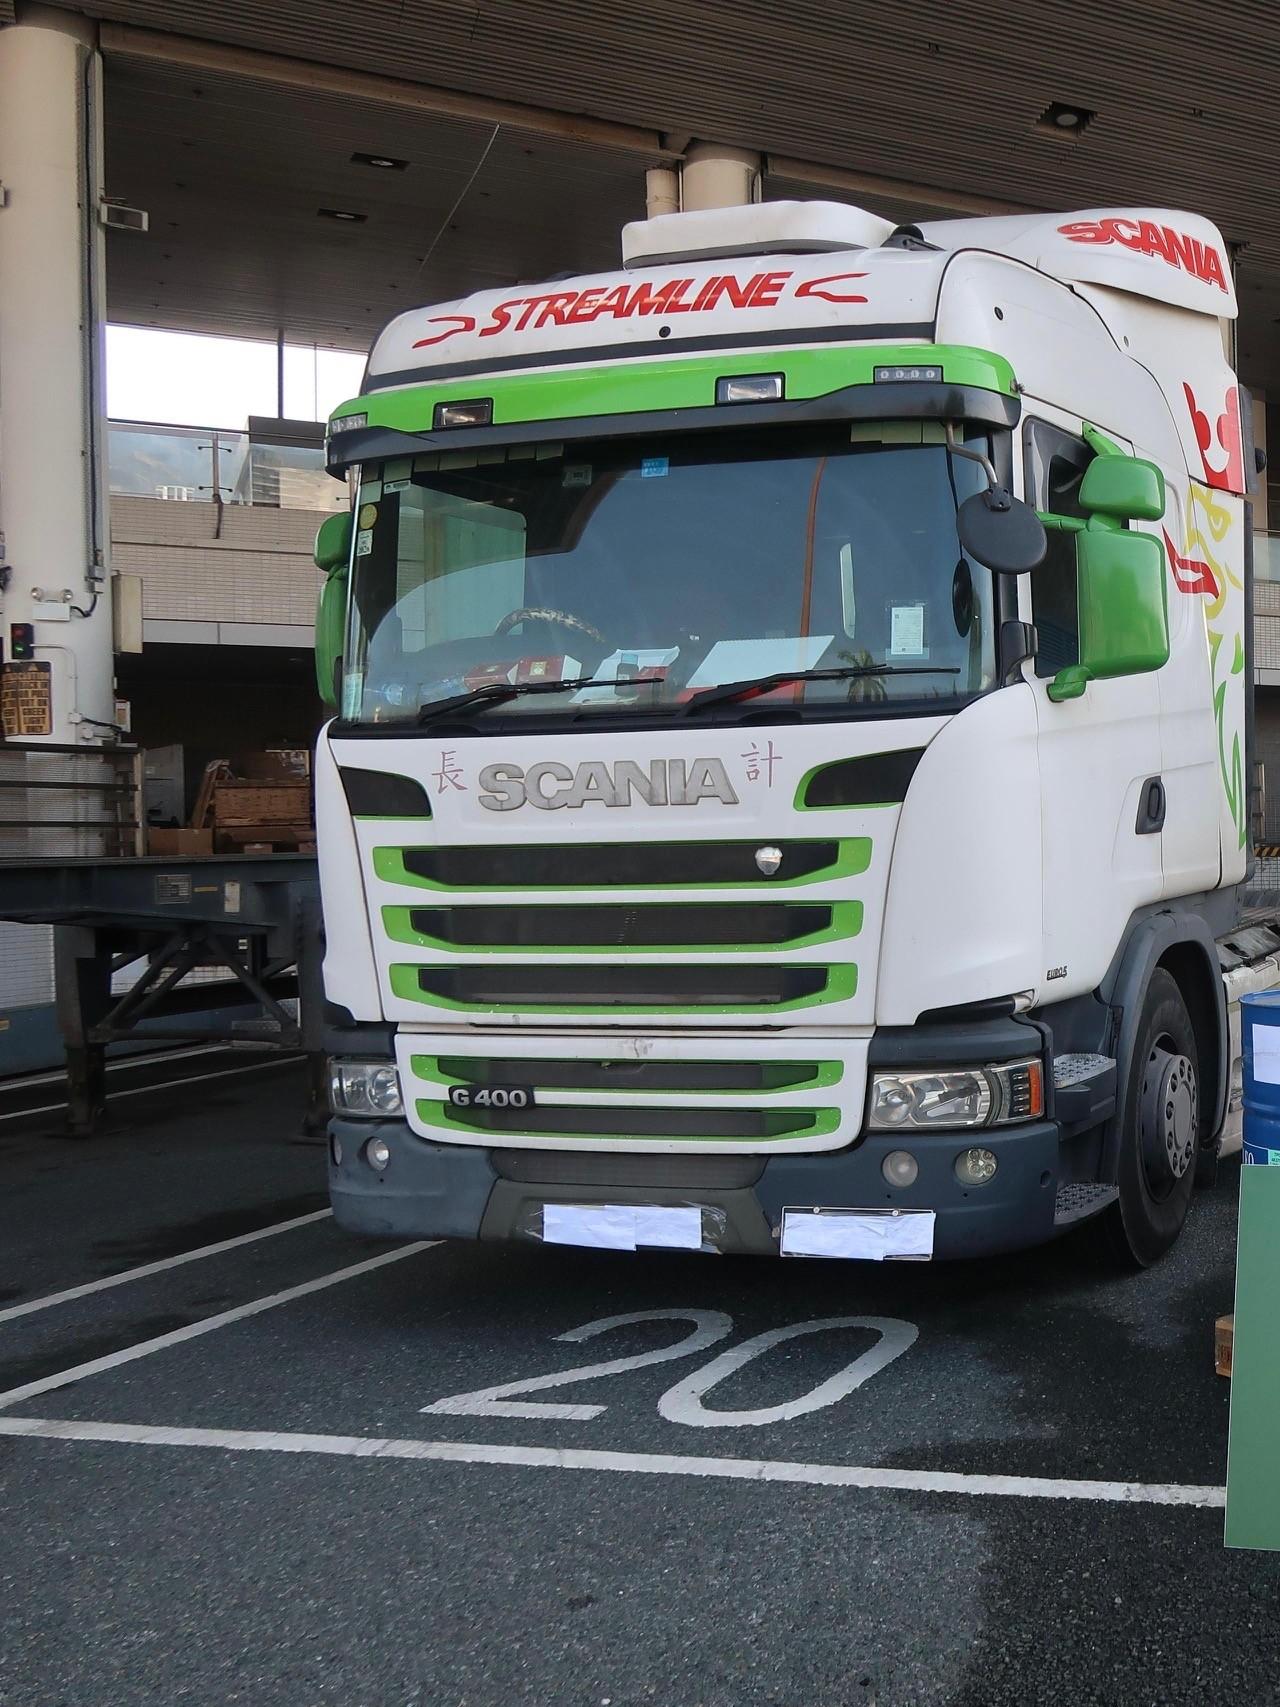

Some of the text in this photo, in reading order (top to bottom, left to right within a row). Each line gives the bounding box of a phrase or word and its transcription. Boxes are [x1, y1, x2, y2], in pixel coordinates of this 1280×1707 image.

[1057, 217, 1229, 295] SCANIA
[479, 271, 794, 337] STREAMLINE
[431, 749, 468, 795] 長
[478, 758, 739, 811] SCANIA
[741, 740, 783, 788] 計
[452, 1089, 527, 1107] G 400
[418, 1308, 919, 1427] 20
